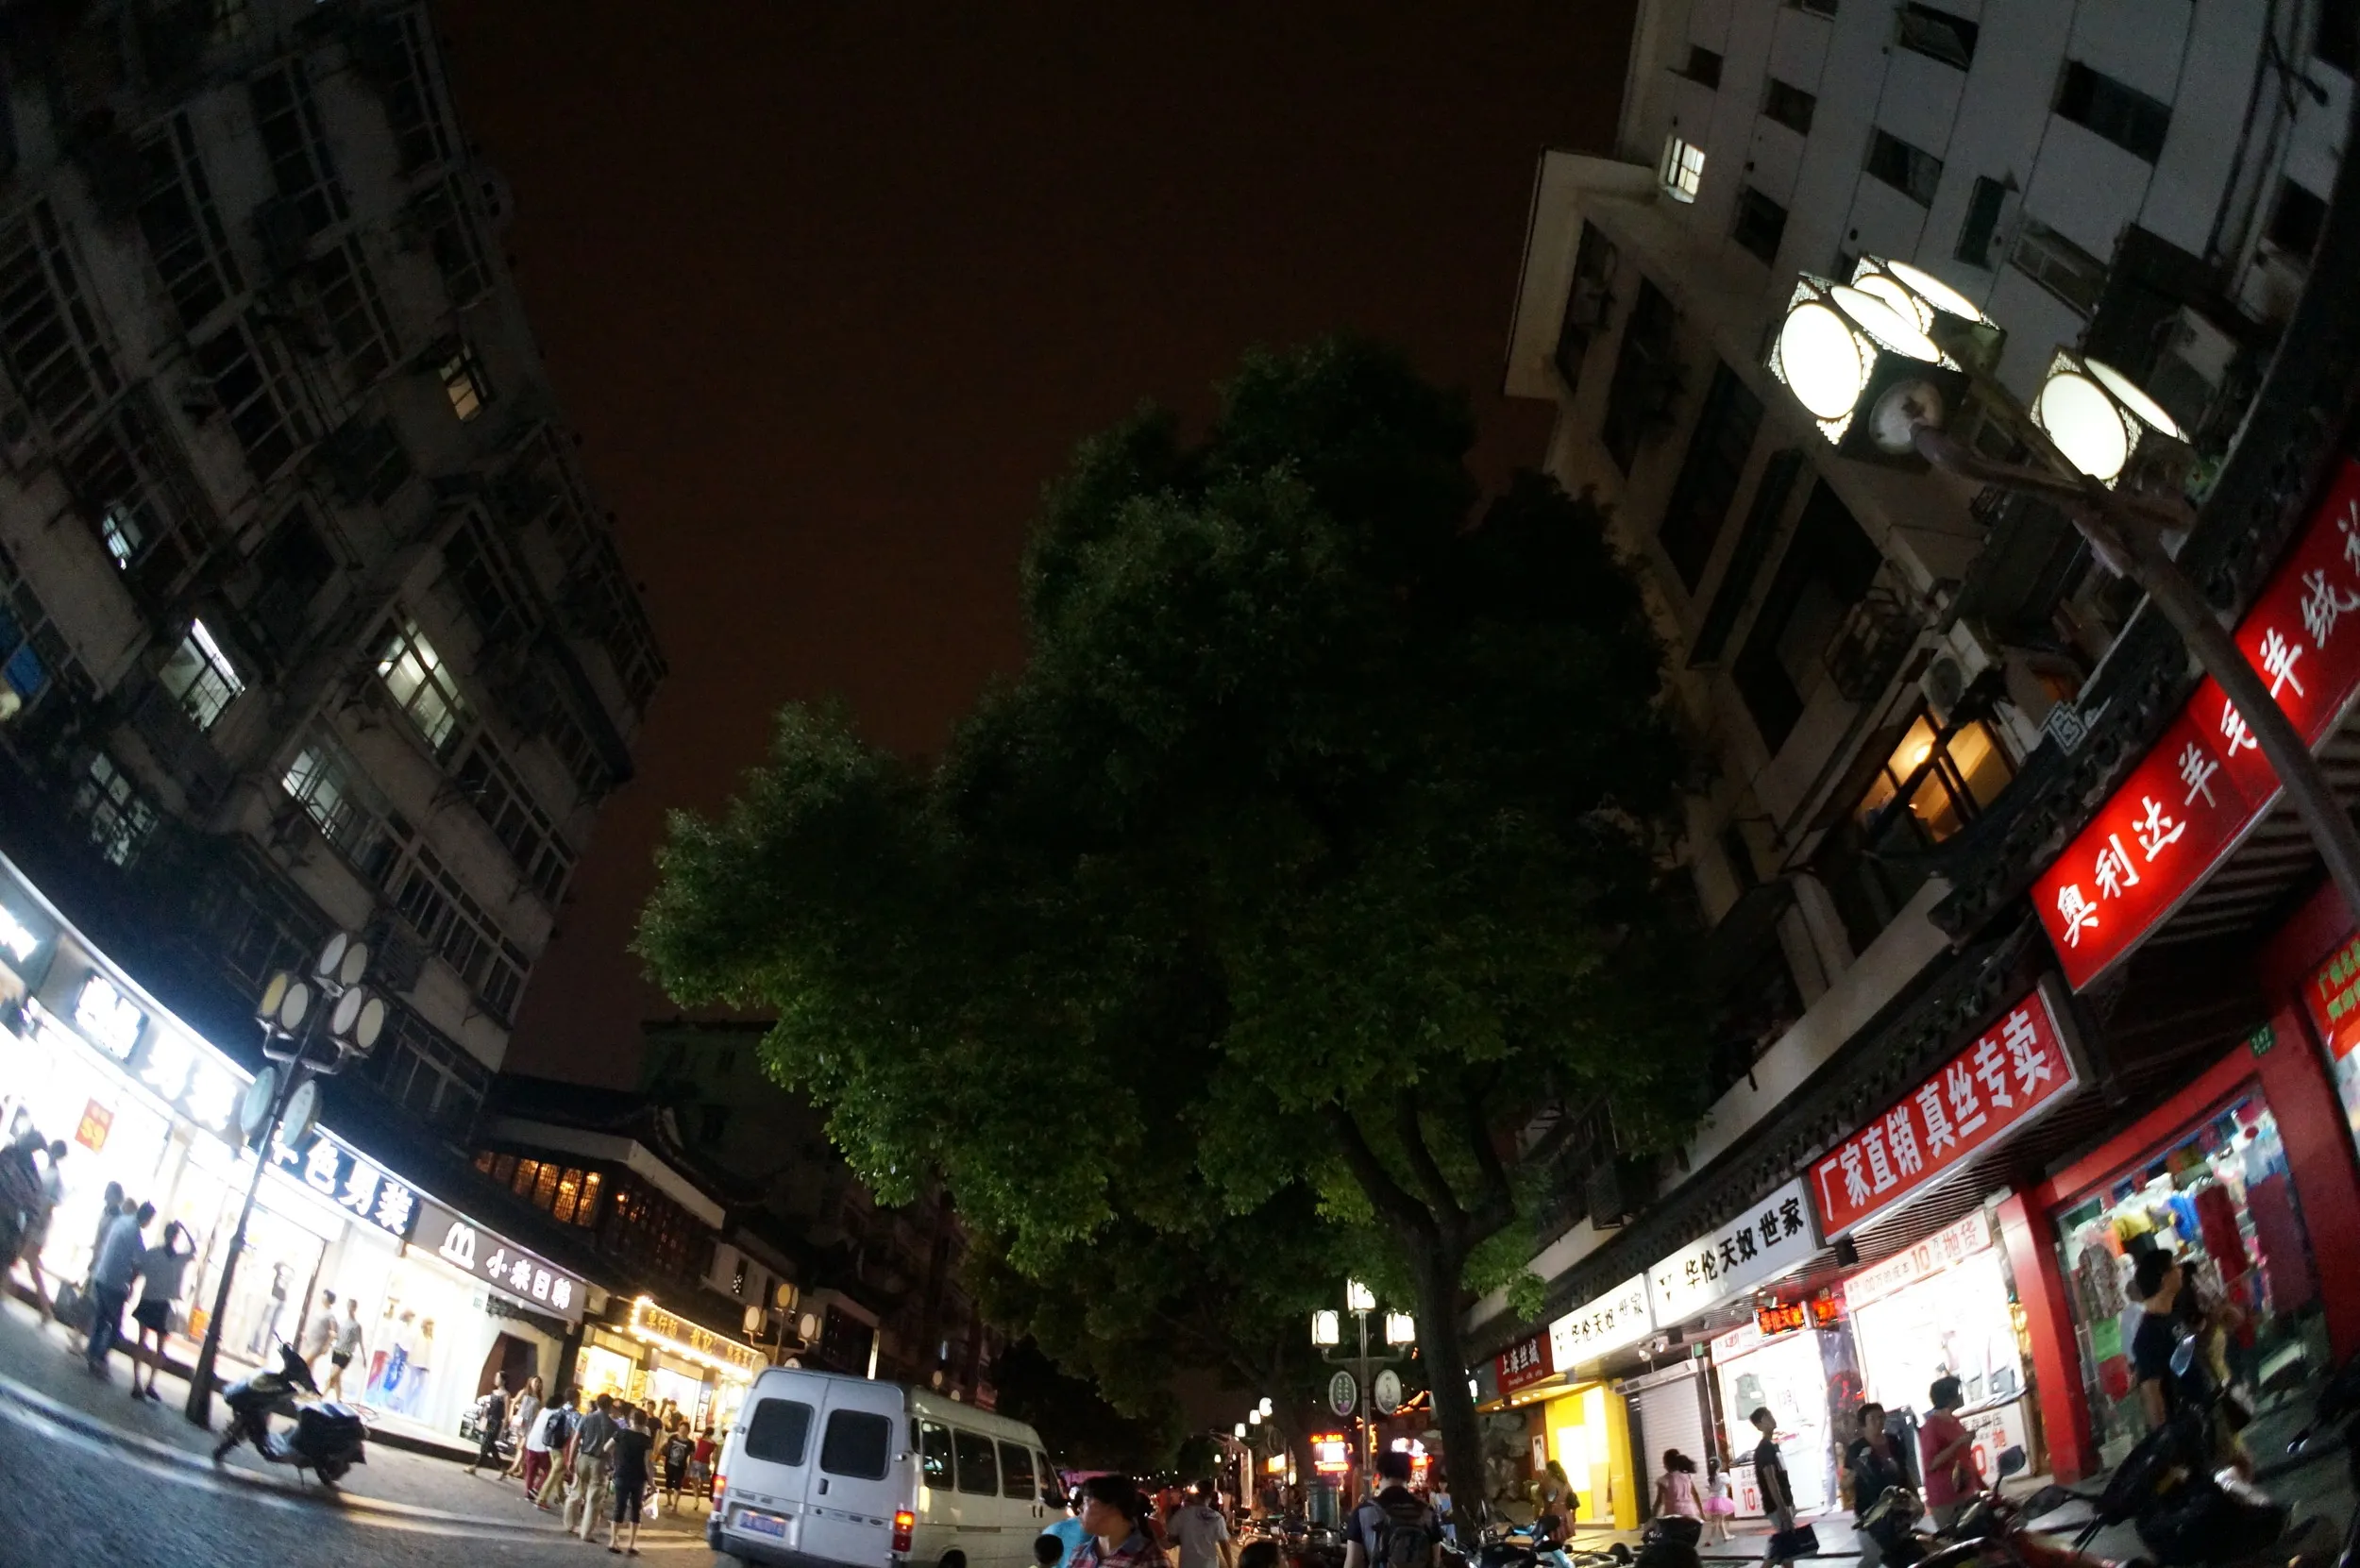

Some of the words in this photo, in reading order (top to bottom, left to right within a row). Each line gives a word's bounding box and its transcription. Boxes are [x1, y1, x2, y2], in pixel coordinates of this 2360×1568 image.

[1818, 1009, 2051, 1222] 厂家直销真丝专卖
